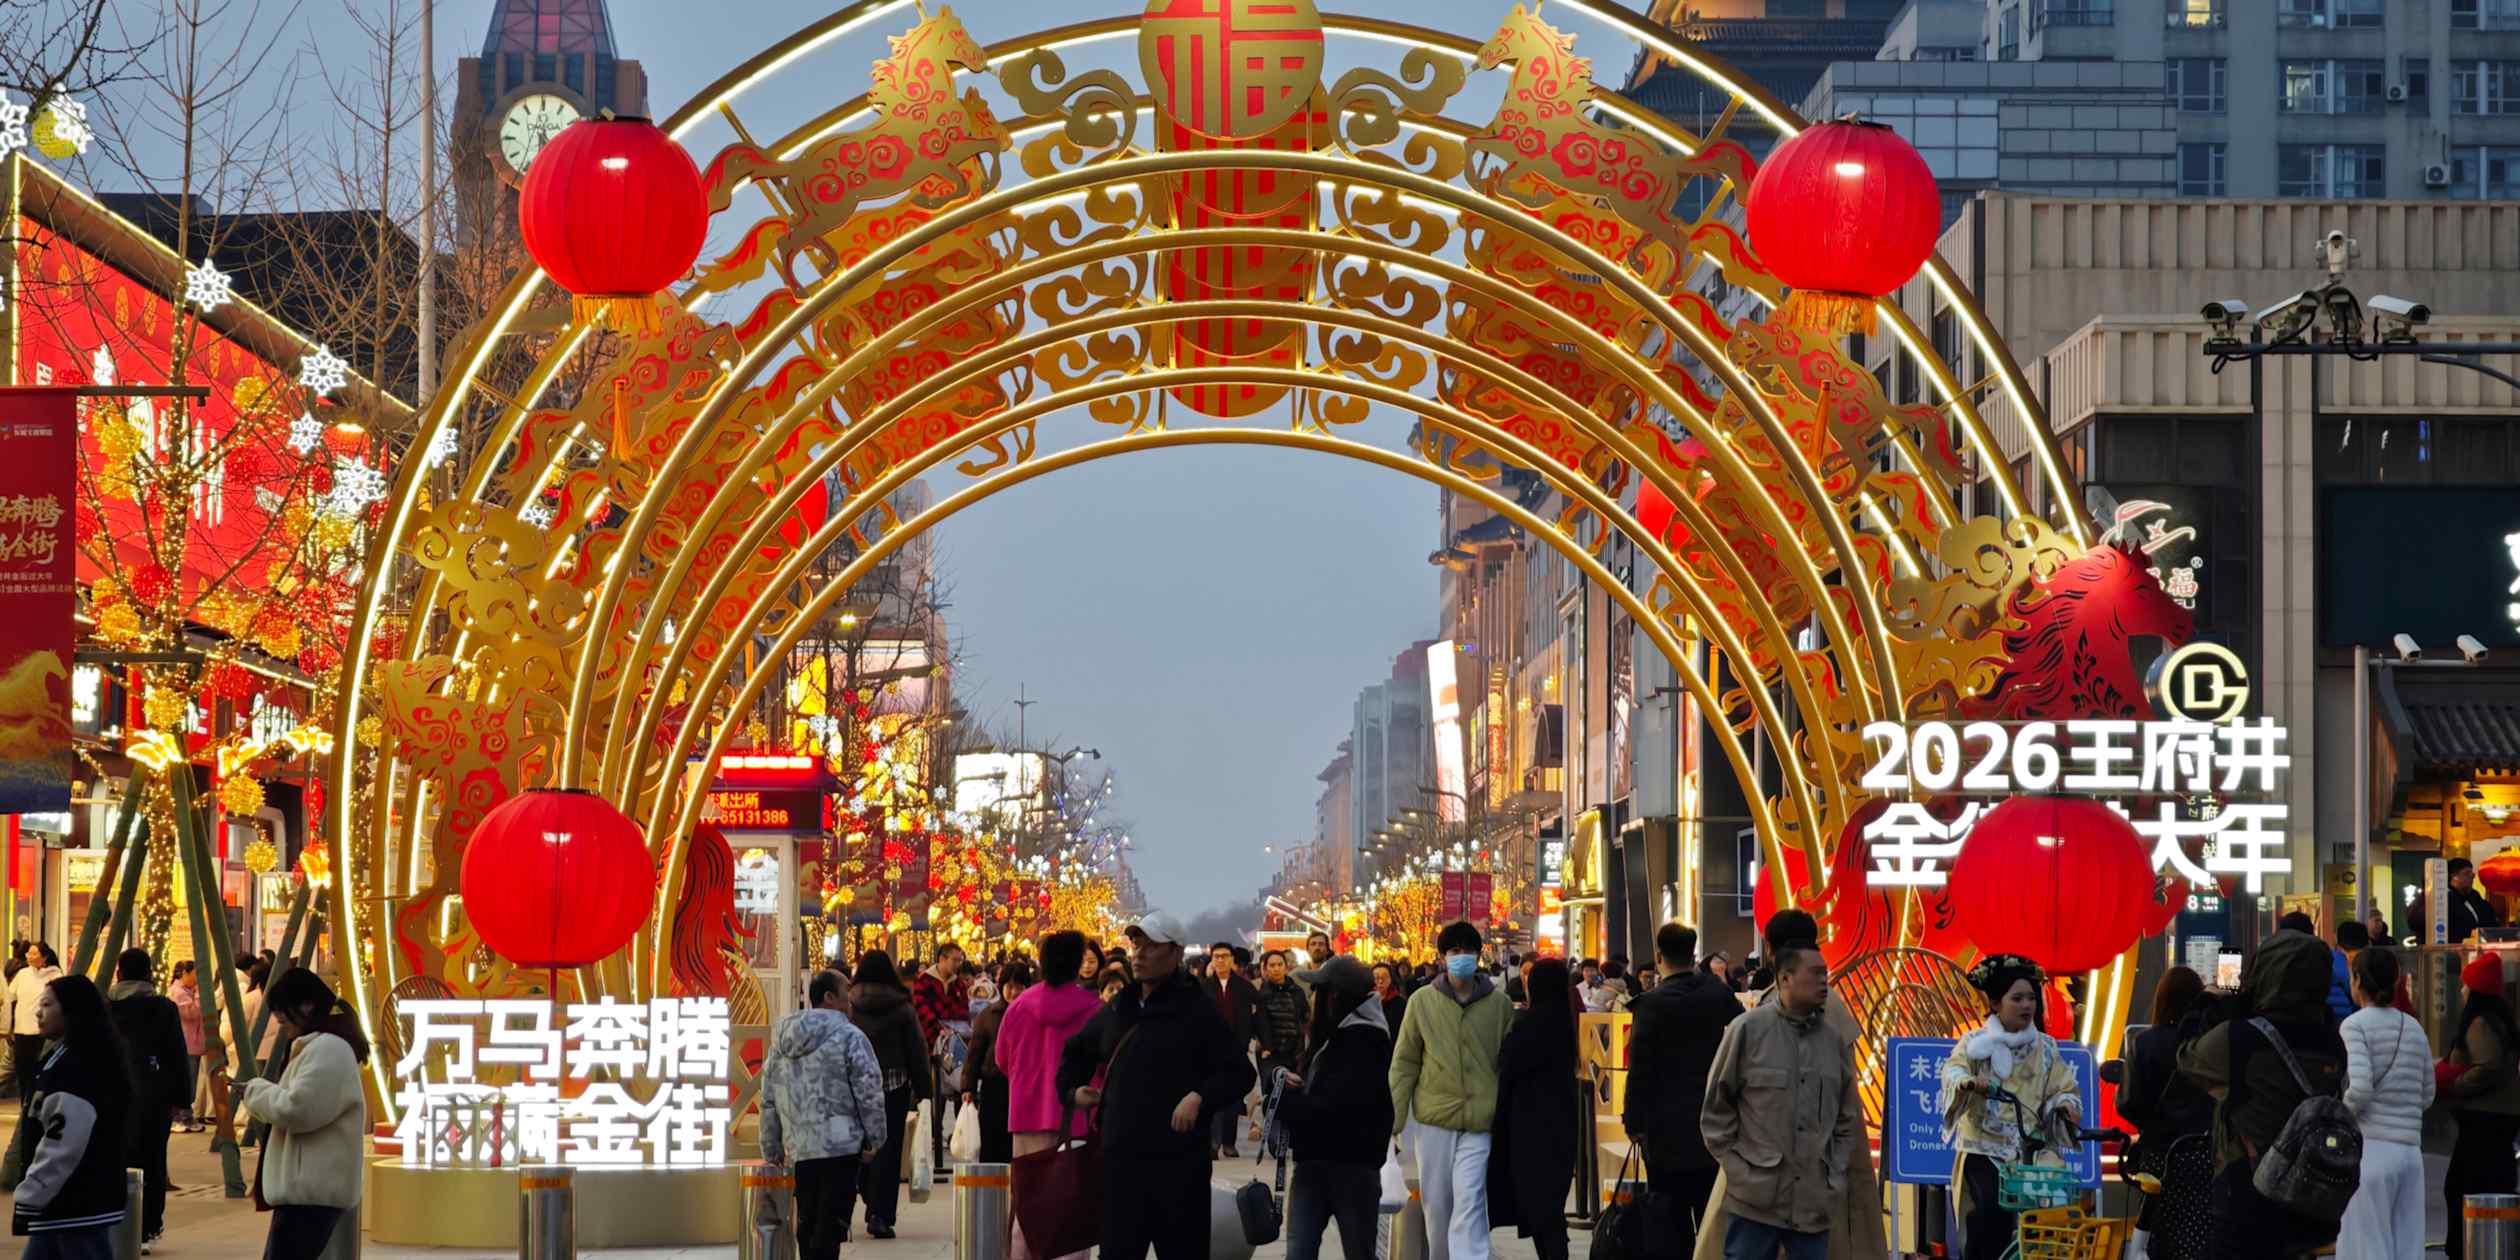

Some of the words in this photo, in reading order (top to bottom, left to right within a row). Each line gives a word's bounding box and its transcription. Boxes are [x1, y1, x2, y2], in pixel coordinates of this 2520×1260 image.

[1861, 717, 2291, 790] 2026王府井
[396, 996, 730, 1078] 万马奔腾
[1910, 1121, 1934, 1135] Only
